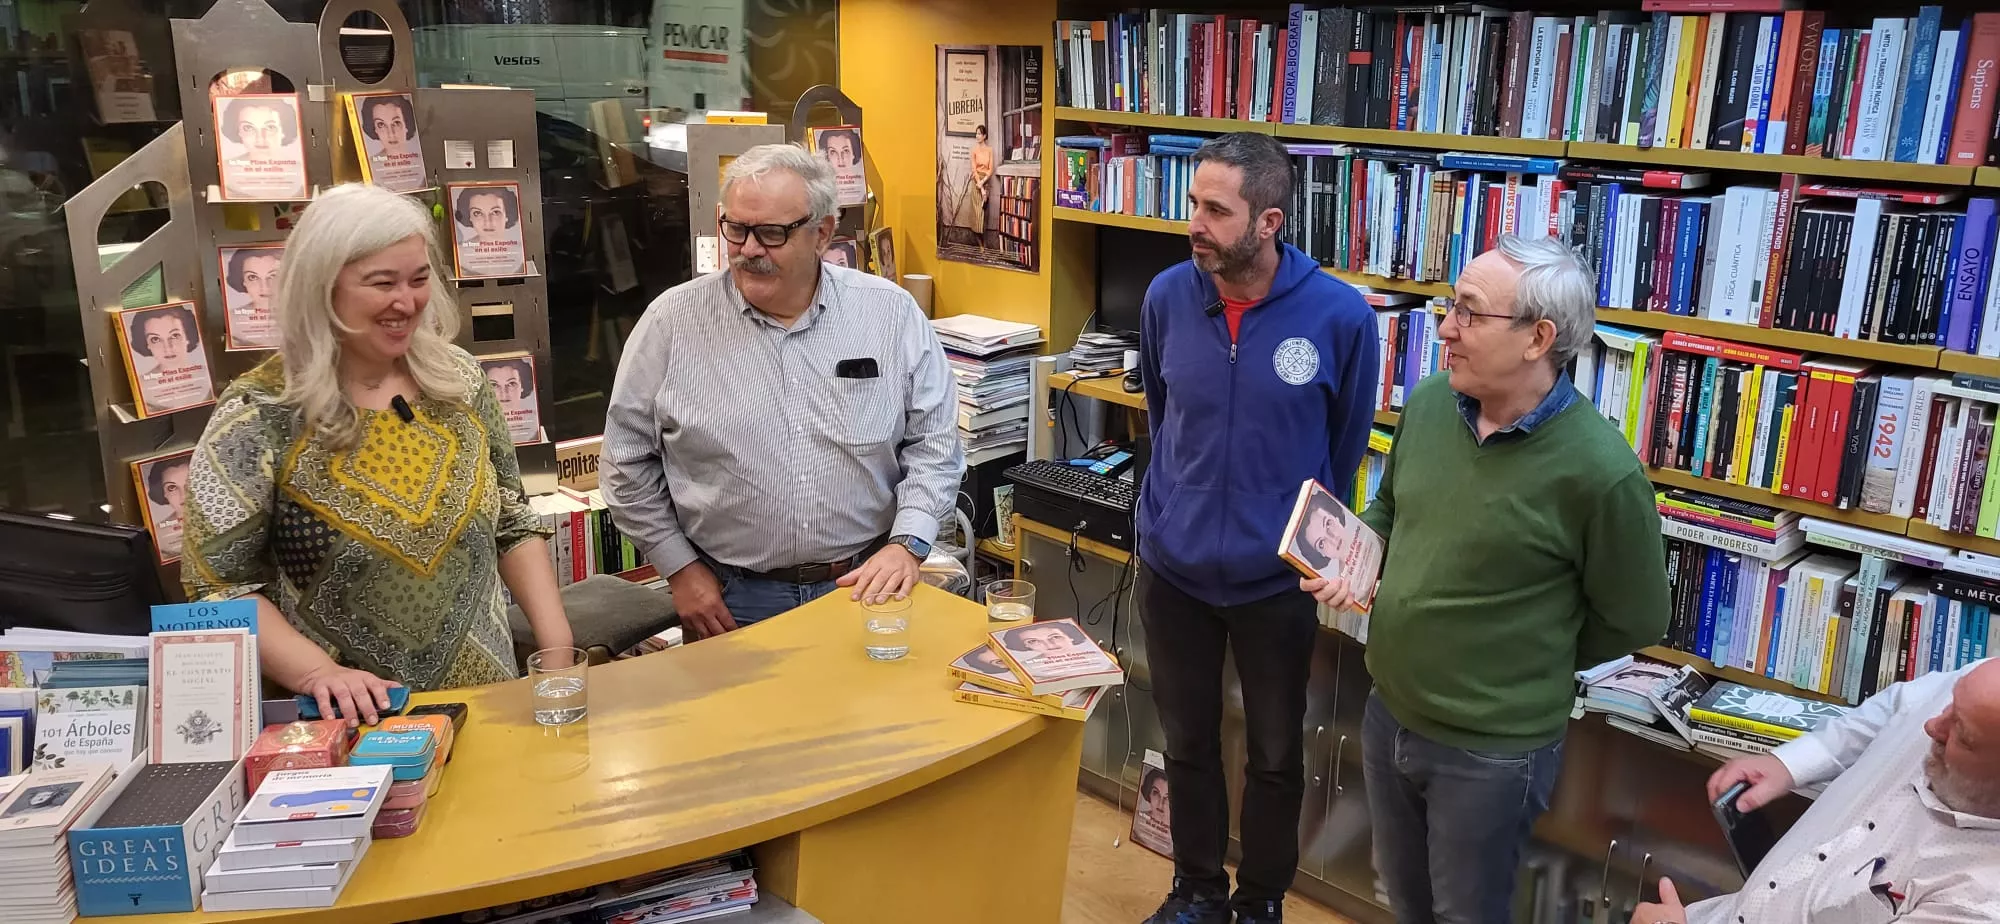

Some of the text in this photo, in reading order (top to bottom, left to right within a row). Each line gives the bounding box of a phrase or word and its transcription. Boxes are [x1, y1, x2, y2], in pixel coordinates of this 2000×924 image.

[664, 23, 728, 50] PEMICAR
[1533, 34, 1544, 66] EXCEPCIÓN
[1799, 18, 1820, 73] ROMA
[1882, 33, 1891, 48] MITO
[494, 55, 540, 66] Vestas
[1284, 9, 1300, 117] HISTORIA-BIOGRAFIA
[1875, 57, 1888, 90] TRANSICIÓN
[1727, 87, 1735, 104] MUSK
[1748, 63, 1764, 109] SALUD GLOBAL
[1970, 59, 1994, 109] Sapiens
[948, 95, 983, 116] LIBRERÍA
[1871, 90, 1882, 115] PACÍFICA
[399, 152, 418, 160] España
[1504, 175, 1517, 235] RLOS SAURA
[1764, 188, 1790, 313] EL FRANQUISMO GONZALO PONTÓN
[1727, 244, 1742, 301] FÍSICA CUÁNTICA
[1957, 247, 1980, 301] ENSAYO
[1422, 326, 1432, 362] Feminismos
[162, 369, 177, 377] Miss
[178, 364, 203, 374] España
[175, 373, 193, 381] exilio
[1671, 358, 1688, 413] ARTIFICIAL
[1909, 388, 1928, 431] JEFFRIES
[1849, 433, 1860, 454] GAZA
[1873, 413, 1897, 459] 1942
[557, 452, 600, 484] pepitas
[1947, 455, 1959, 499] CRIPTOMONEDAS
[1675, 526, 1759, 553] PODER PROGRESO
[1703, 571, 1717, 626] NUESTRO CUERPO
[1954, 588, 1963, 596] EL
[159, 617, 250, 632] MODERNOS
[188, 606, 218, 617] LOS
[1067, 650, 1096, 658] España
[43, 718, 131, 738] 101 Árboles
[64, 737, 113, 749] de España
[1725, 739, 1742, 747] TIEMPO
[79, 838, 174, 858] GREAT
[82, 855, 179, 875] IDEAS
